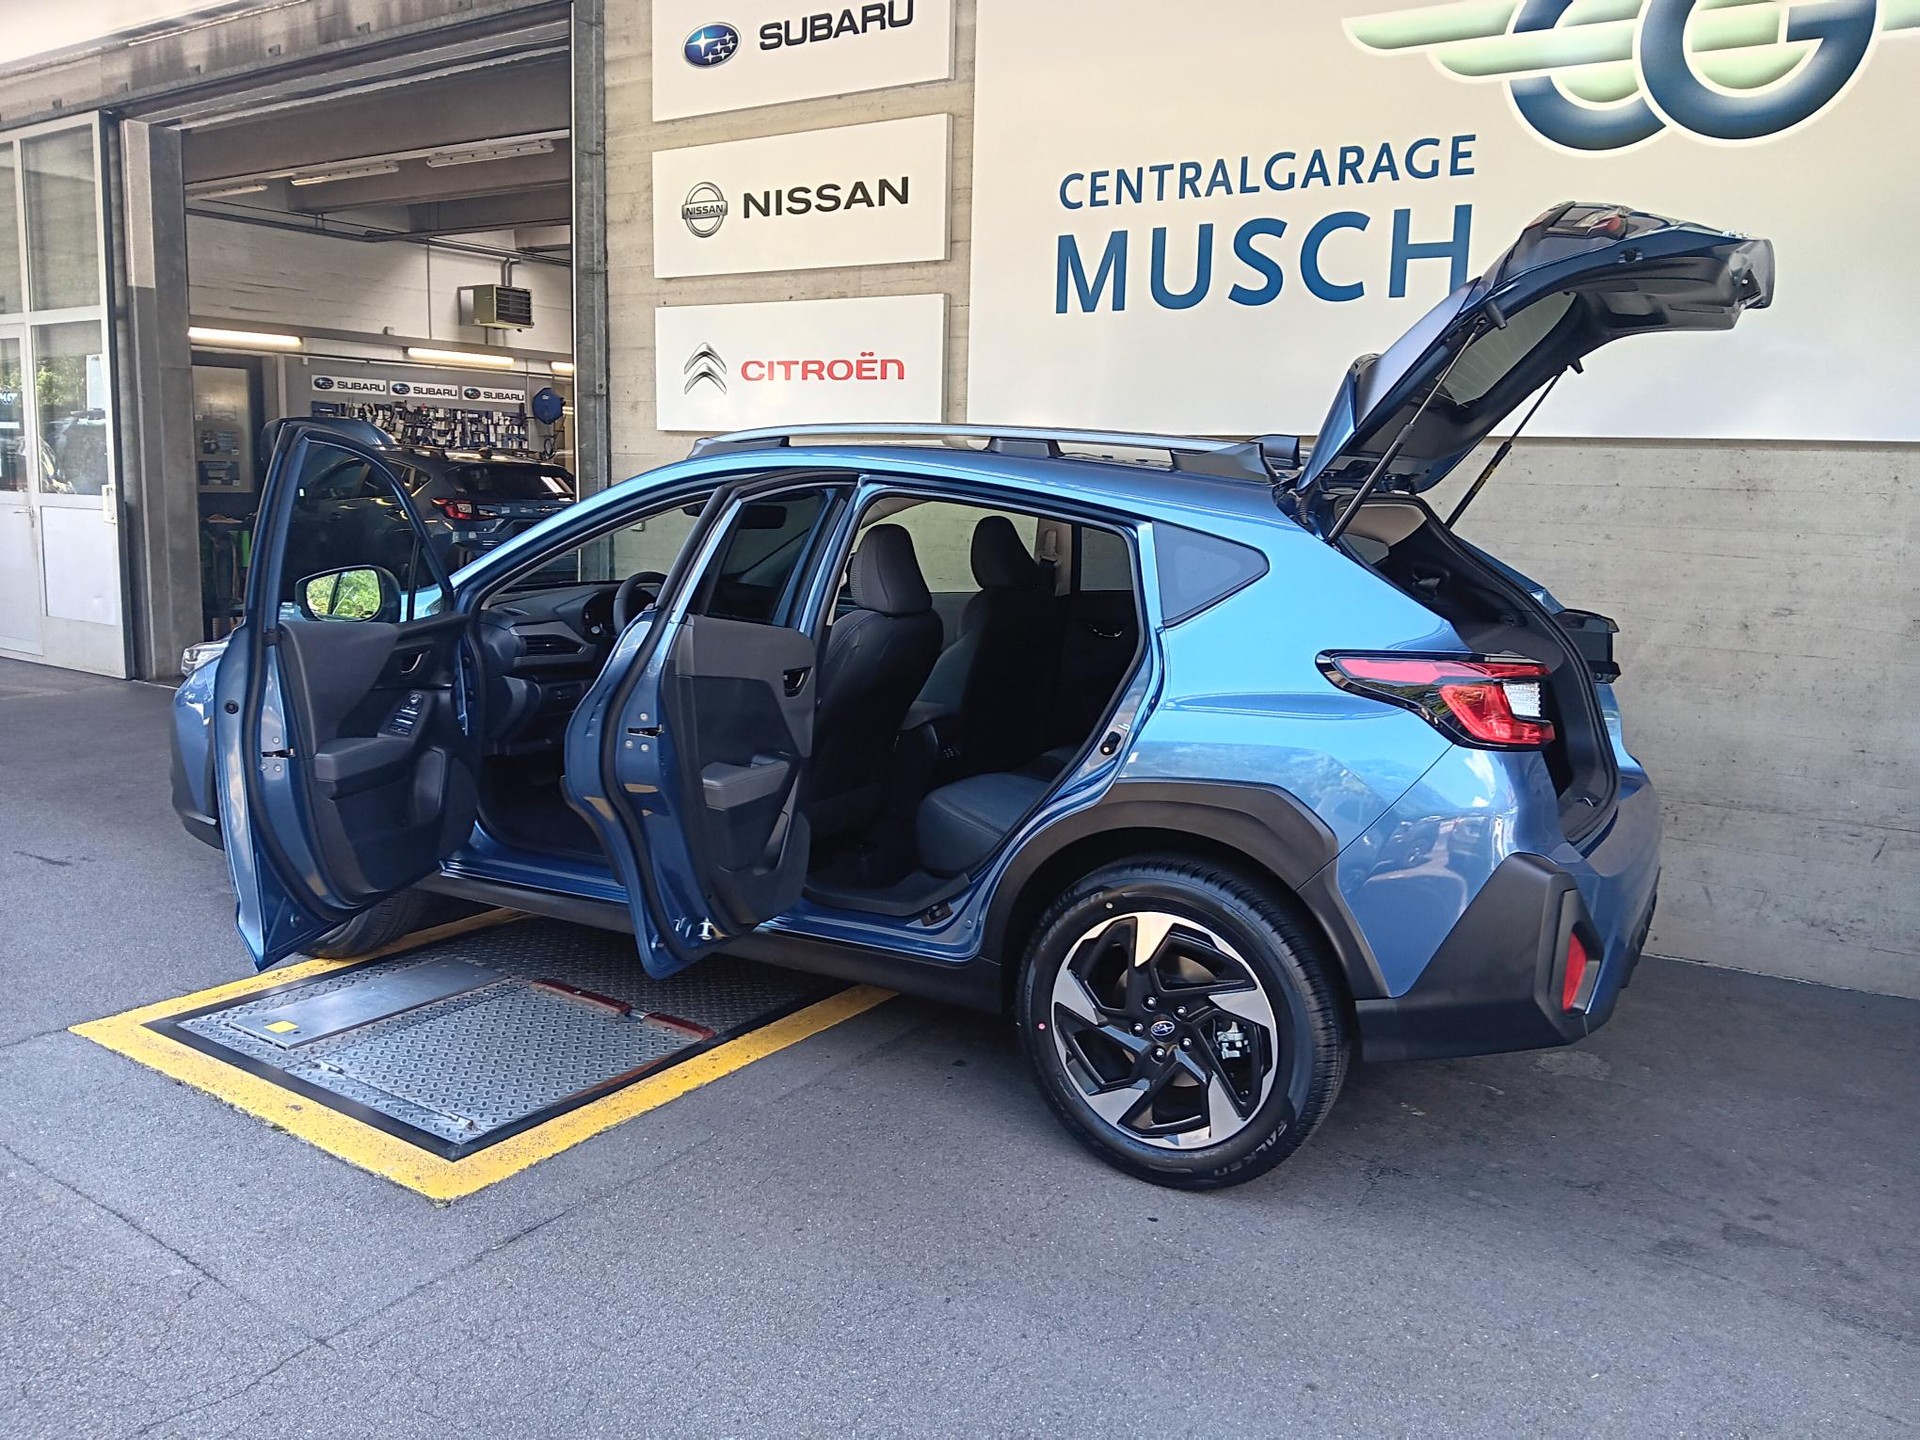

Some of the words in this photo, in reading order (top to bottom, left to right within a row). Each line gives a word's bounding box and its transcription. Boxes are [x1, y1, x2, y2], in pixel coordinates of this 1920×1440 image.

[759, 0, 914, 51] SUBARU
[1058, 133, 1477, 210] CENTRALGARAGE
[685, 203, 725, 216] NISSAN
[743, 176, 909, 219] NISSAN
[1055, 203, 1473, 315] MUSCH
[337, 380, 386, 393] SUBARU
[413, 386, 458, 398] SUBARU
[483, 390, 525, 402] SUBARU
